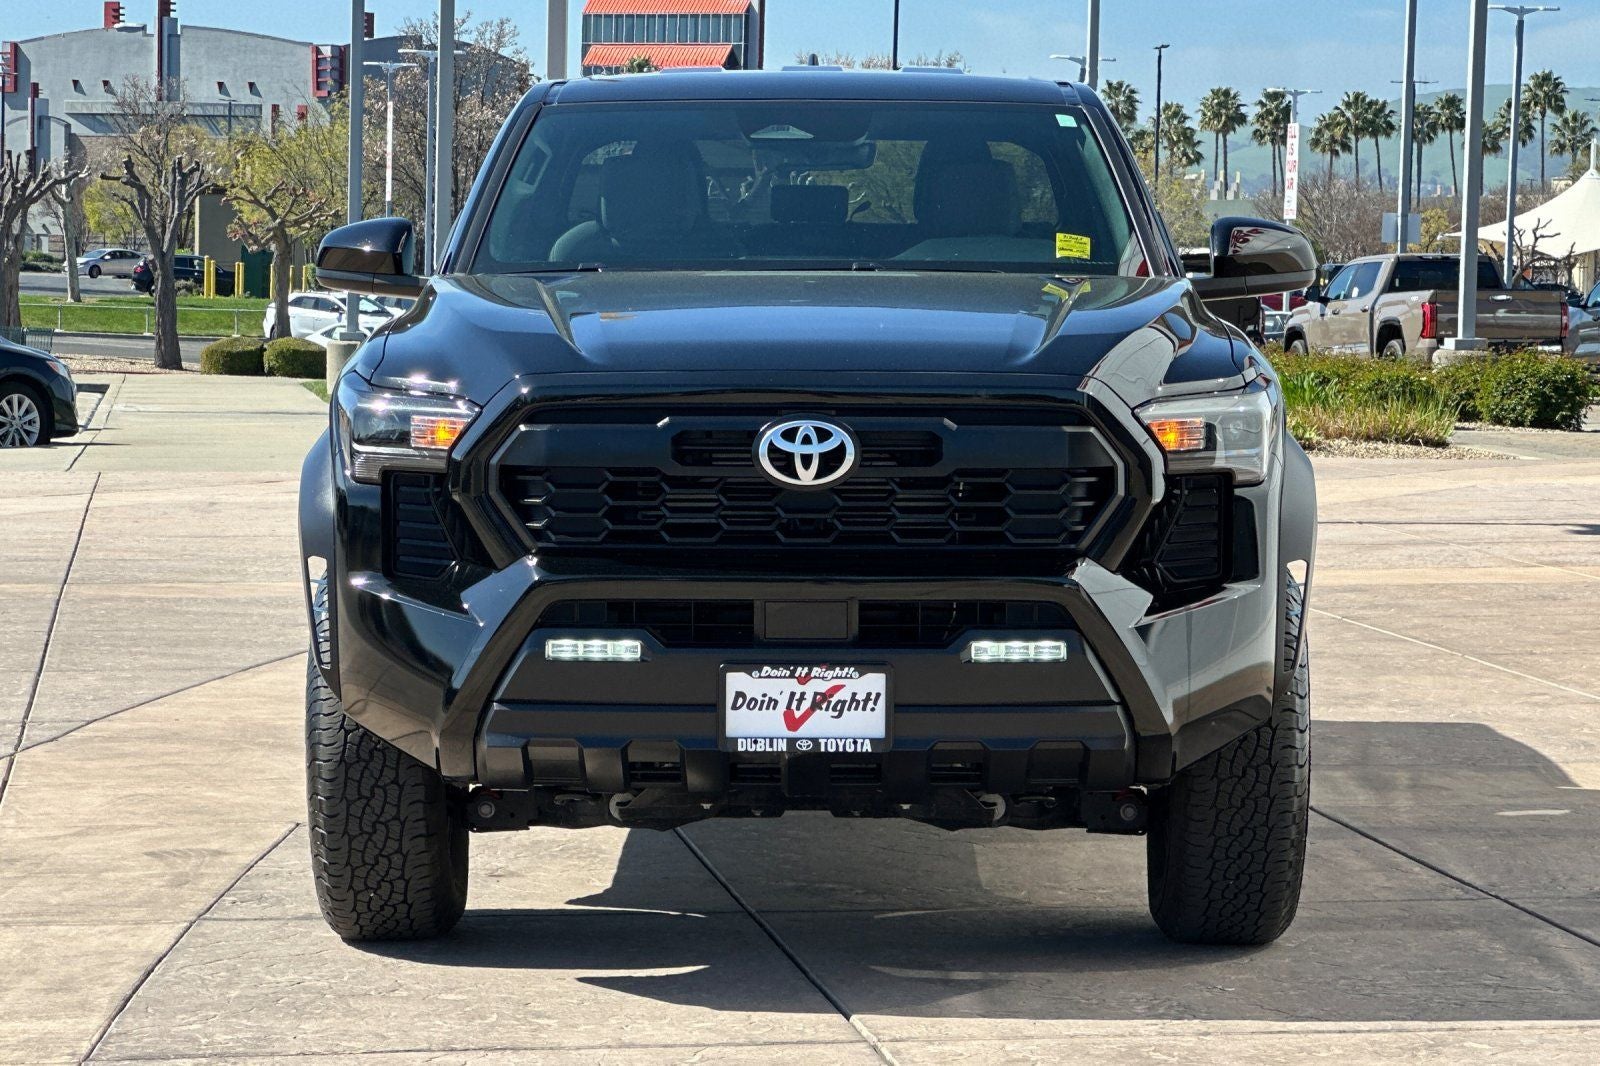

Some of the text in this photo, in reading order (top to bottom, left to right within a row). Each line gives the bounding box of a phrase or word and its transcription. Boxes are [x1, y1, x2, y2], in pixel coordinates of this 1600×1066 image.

[761, 666, 854, 681] Doin' It Right!
[730, 691, 882, 719] Doin' It Right!
[738, 739, 872, 752] DUBLIN TOYOTA
